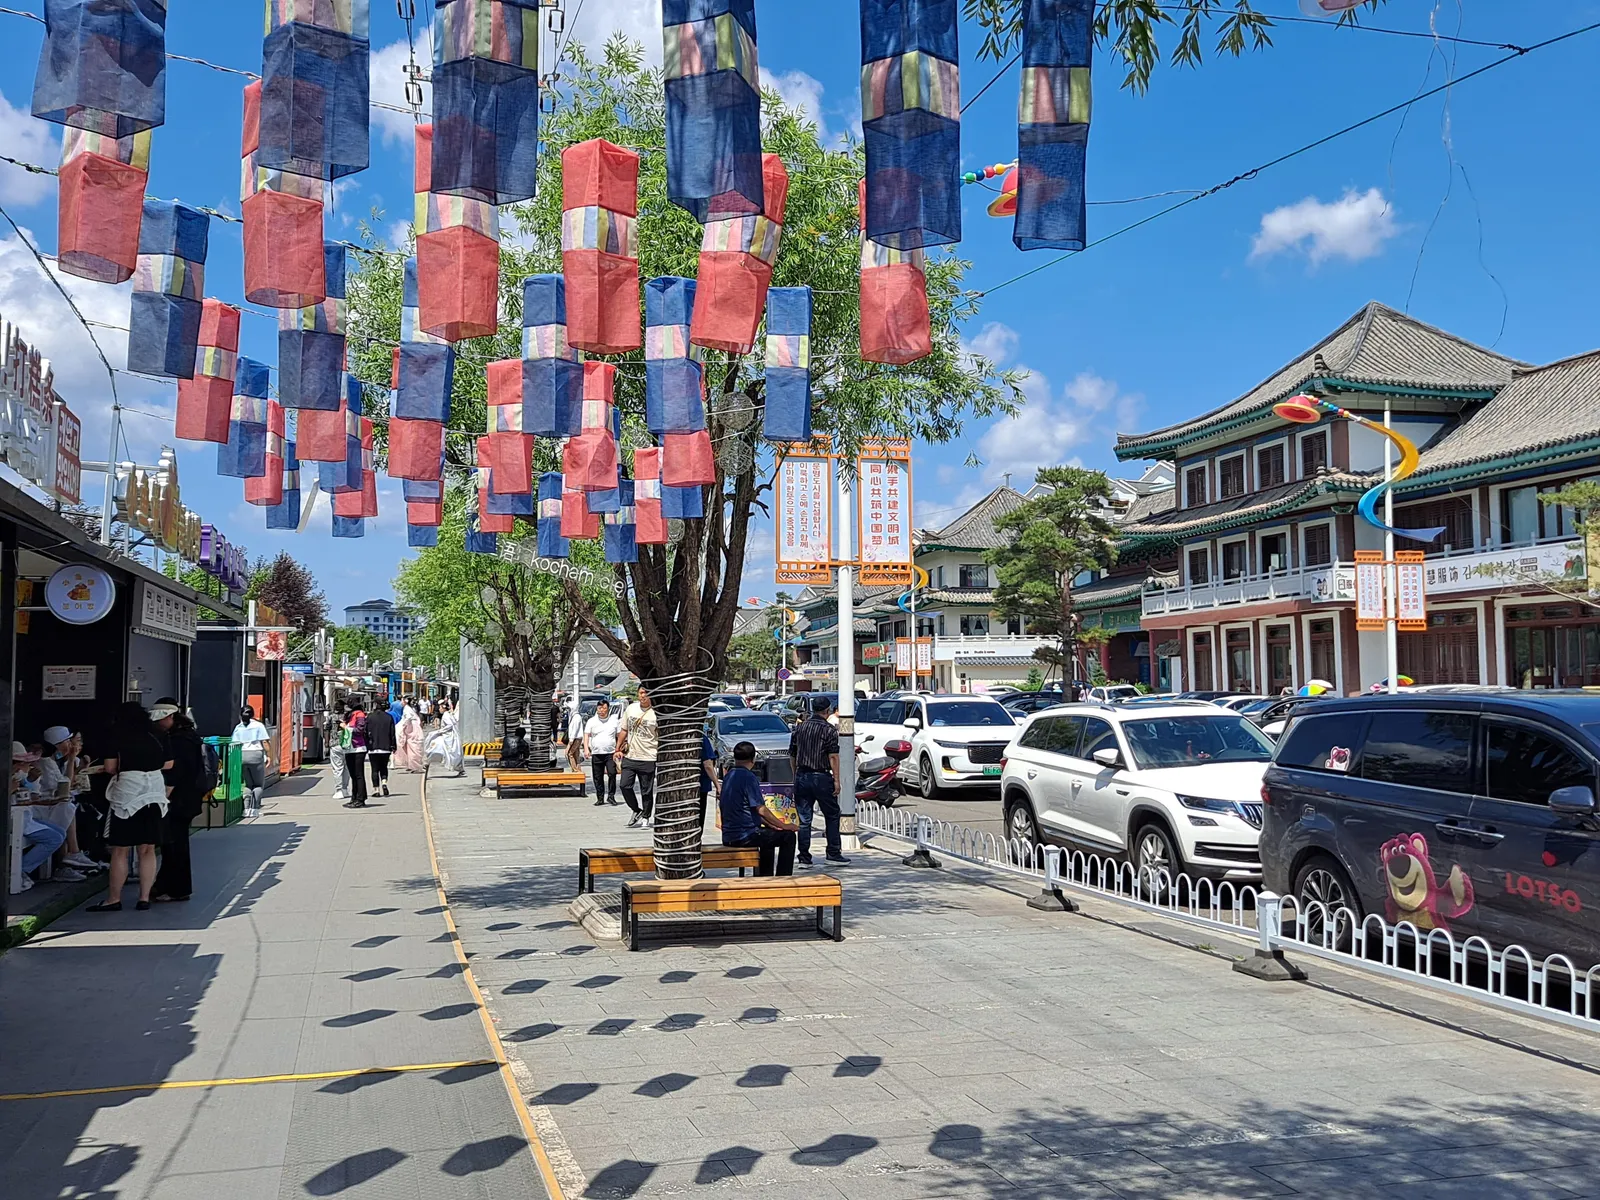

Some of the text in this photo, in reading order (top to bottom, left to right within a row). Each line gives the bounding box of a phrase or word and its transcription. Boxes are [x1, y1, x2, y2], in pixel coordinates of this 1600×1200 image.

[870, 464, 883, 545] 同心共筑中国梦
[886, 464, 900, 545] 携手共建文明城
[530, 550, 594, 585] kocham
[1505, 872, 1583, 913] LOTSO
